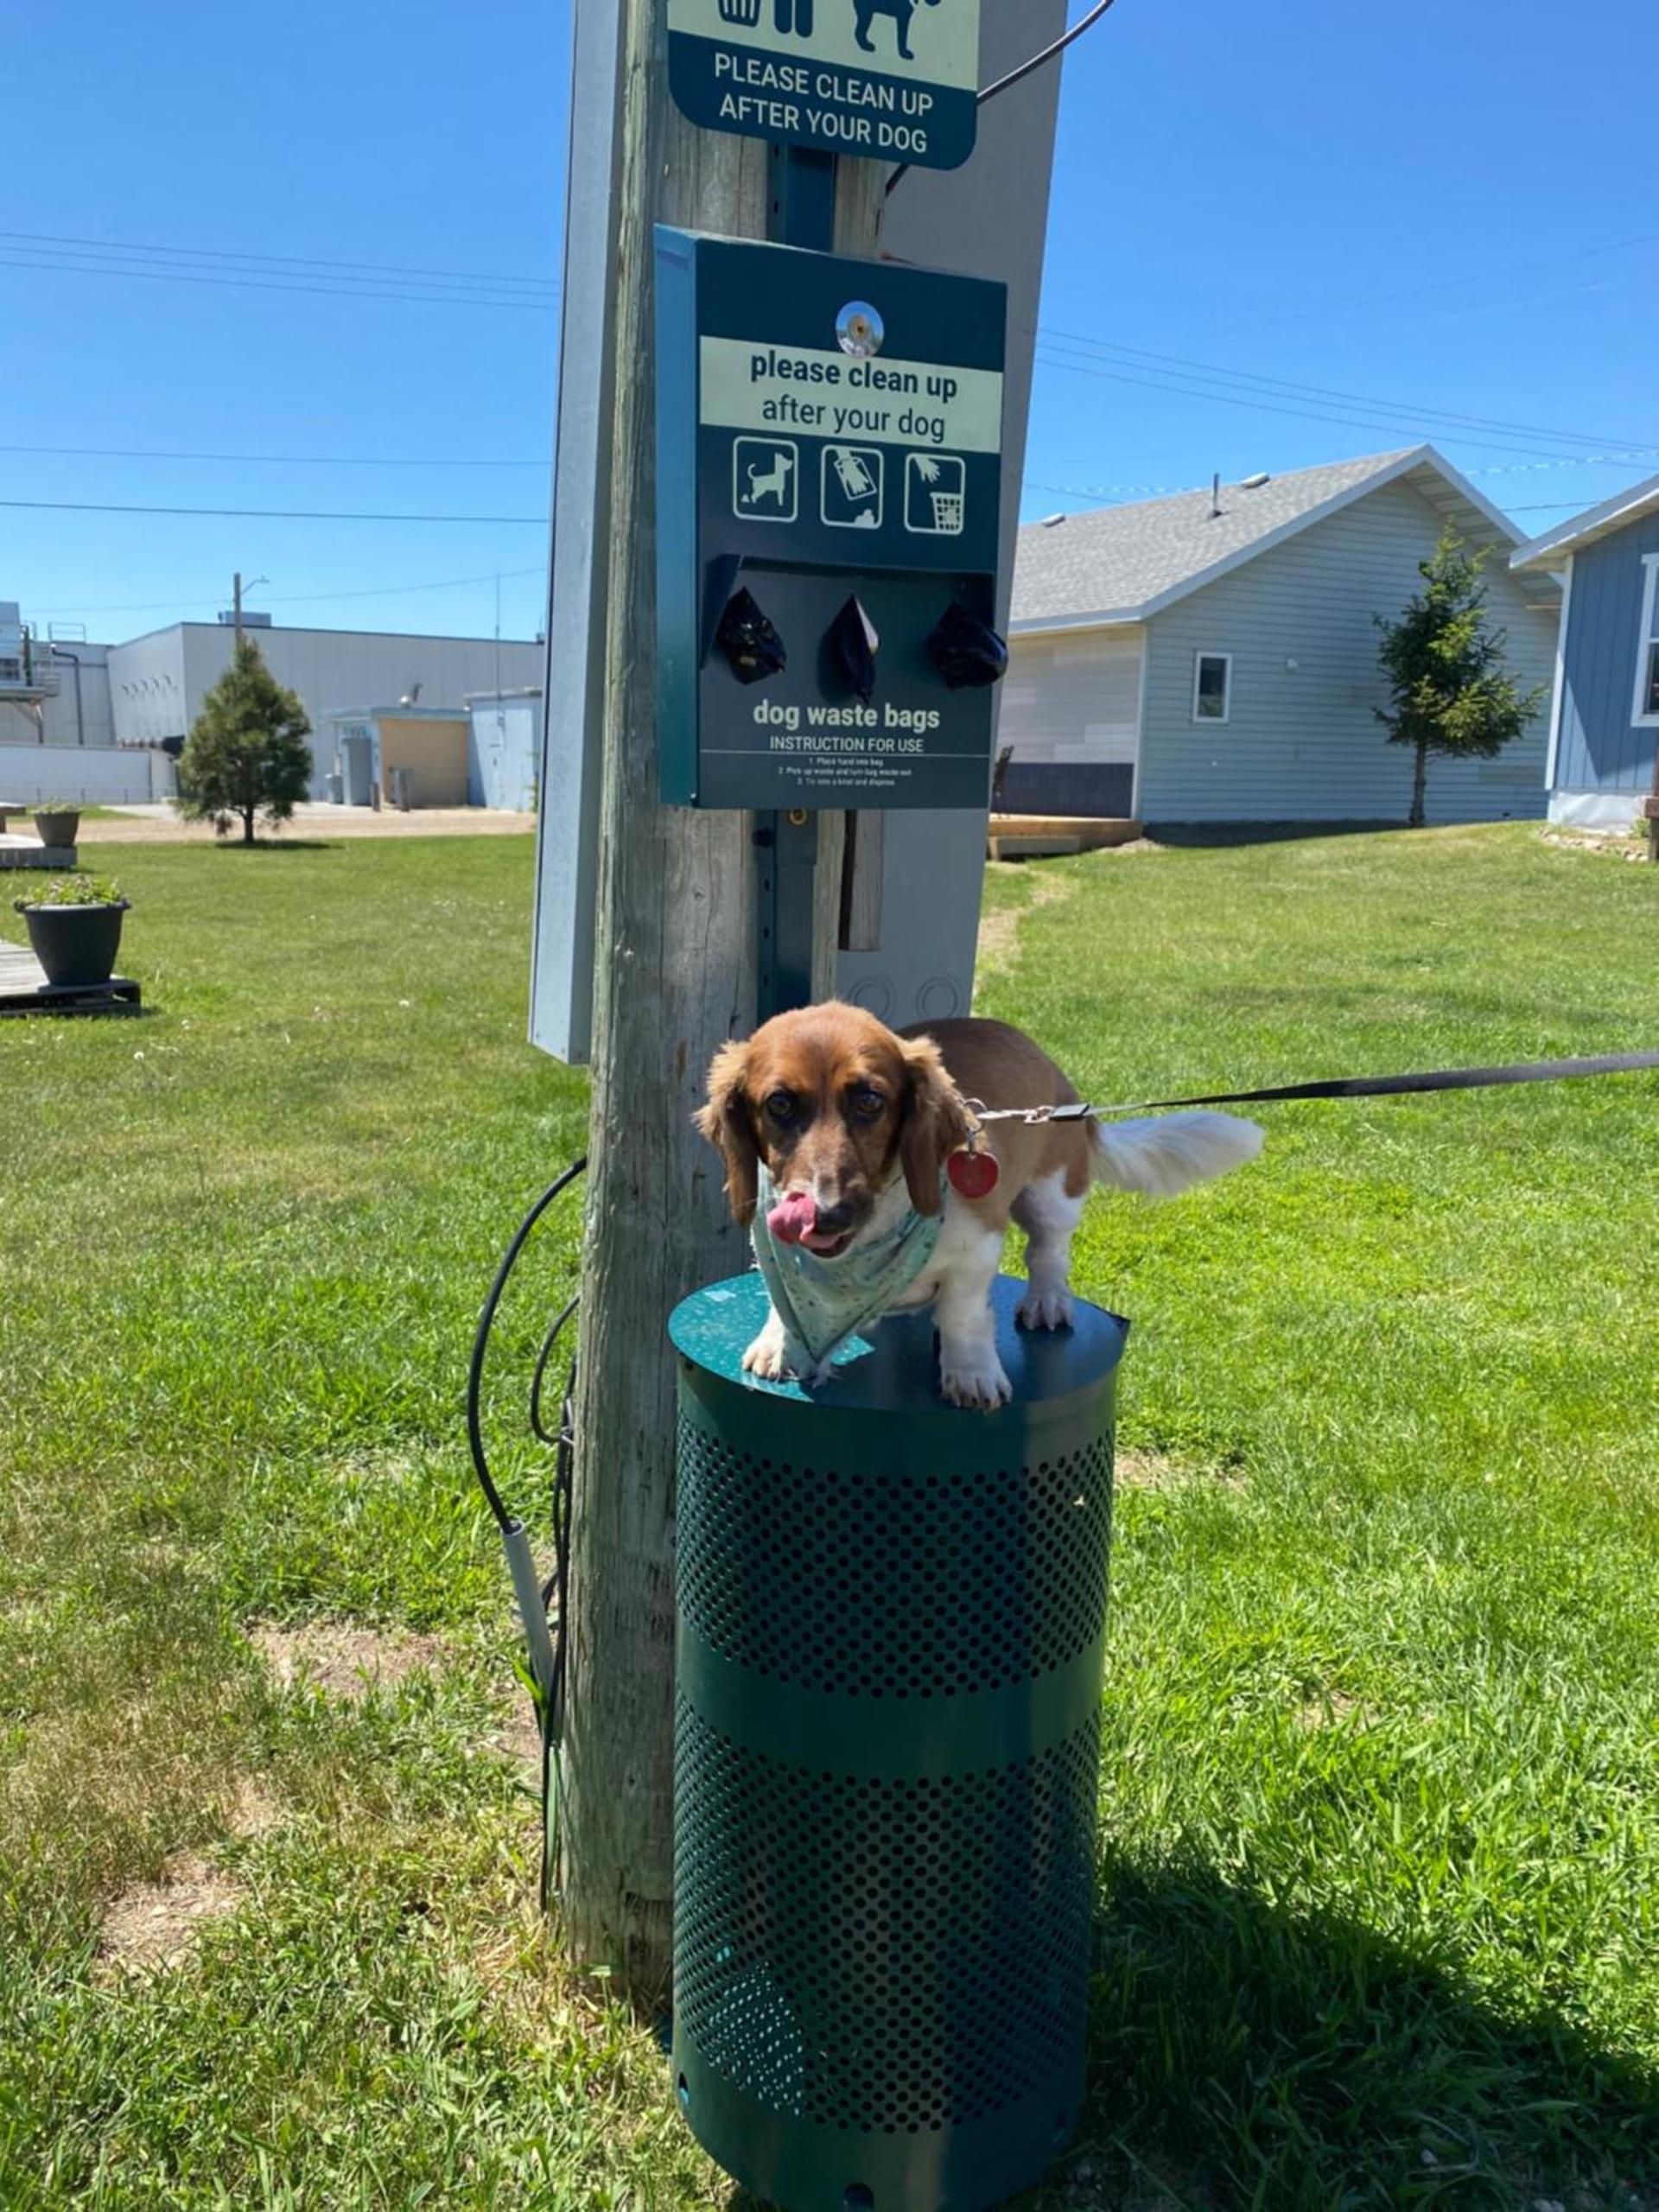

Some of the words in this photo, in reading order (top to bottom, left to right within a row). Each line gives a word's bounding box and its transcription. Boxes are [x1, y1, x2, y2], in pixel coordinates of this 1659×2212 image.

[715, 52, 810, 94] PLEASE
[816, 73, 894, 111] CLEAN
[902, 89, 933, 117] UP
[719, 93, 799, 130] AFTER
[806, 109, 871, 144] YOUR
[878, 123, 927, 153] DOG
[751, 350, 841, 384] please
[849, 362, 918, 393] clean
[927, 376, 957, 404] up
[763, 394, 826, 425] after
[834, 407, 890, 433] your
[898, 409, 944, 444] dog
[753, 698, 799, 731] dog
[807, 705, 878, 727] waste
[885, 702, 940, 734] bags
[770, 736, 864, 751] INSTRUCTION
[868, 739, 895, 752] FOR
[898, 739, 924, 753] USE
